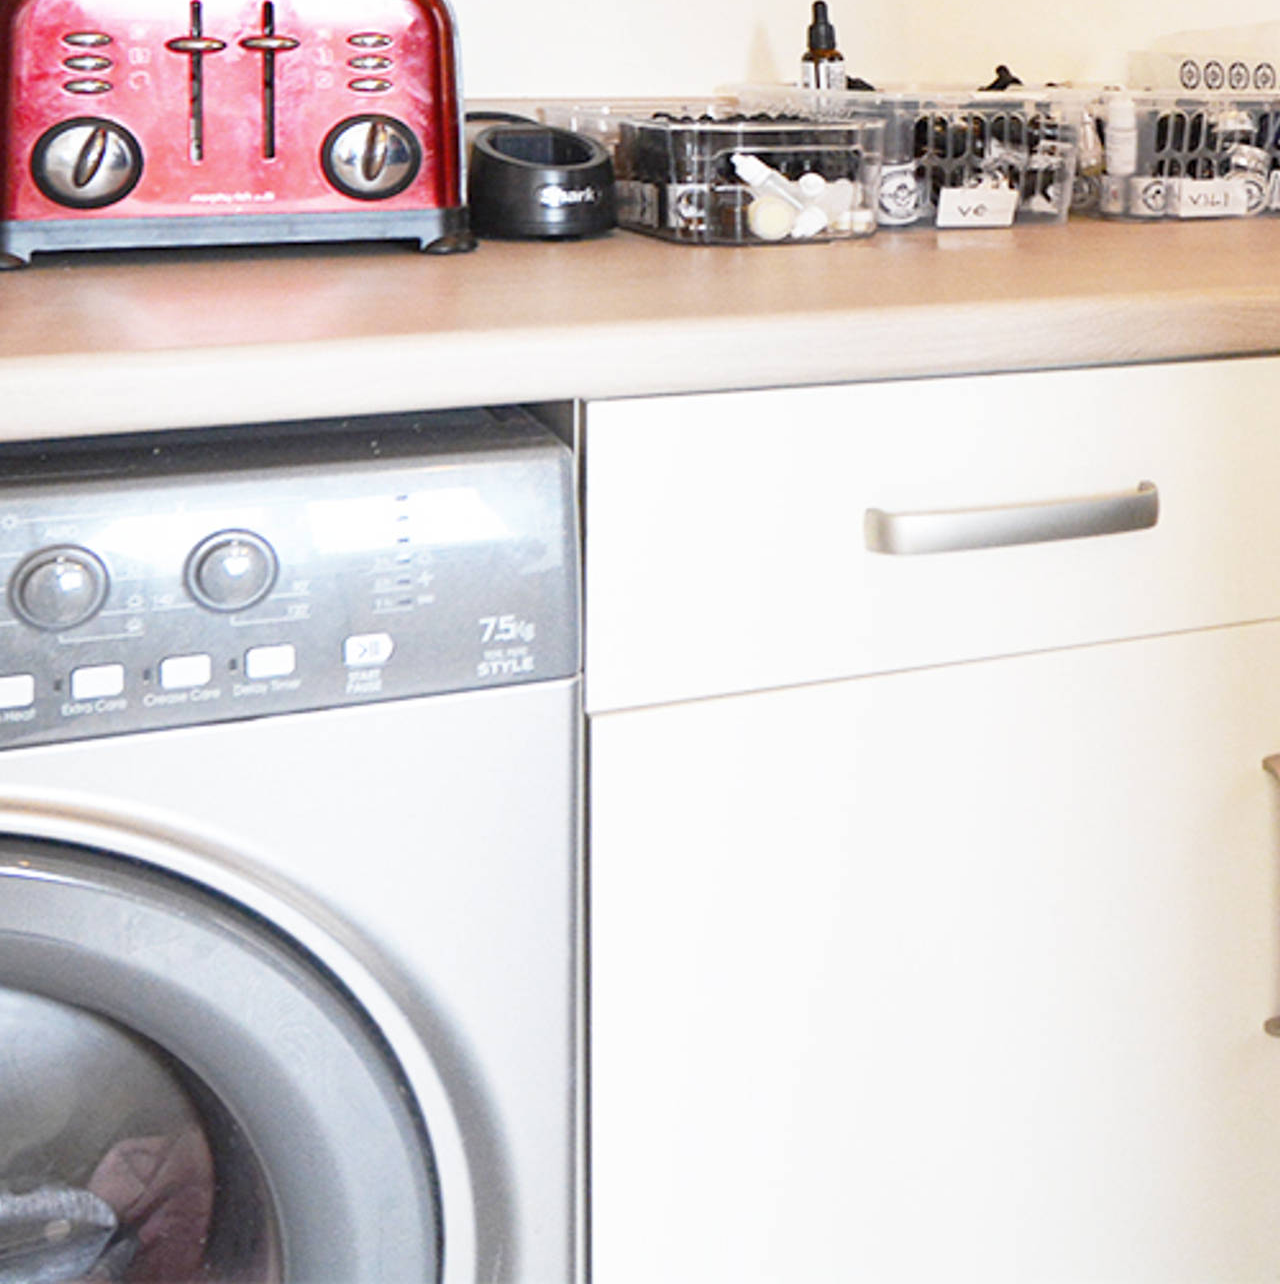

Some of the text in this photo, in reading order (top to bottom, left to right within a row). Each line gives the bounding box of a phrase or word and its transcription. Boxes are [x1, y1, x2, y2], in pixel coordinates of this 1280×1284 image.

[476, 656, 535, 678] STYLE
[189, 687, 222, 703] Care
[2, 707, 37, 724] Heat
[61, 697, 129, 717] Extra Care
